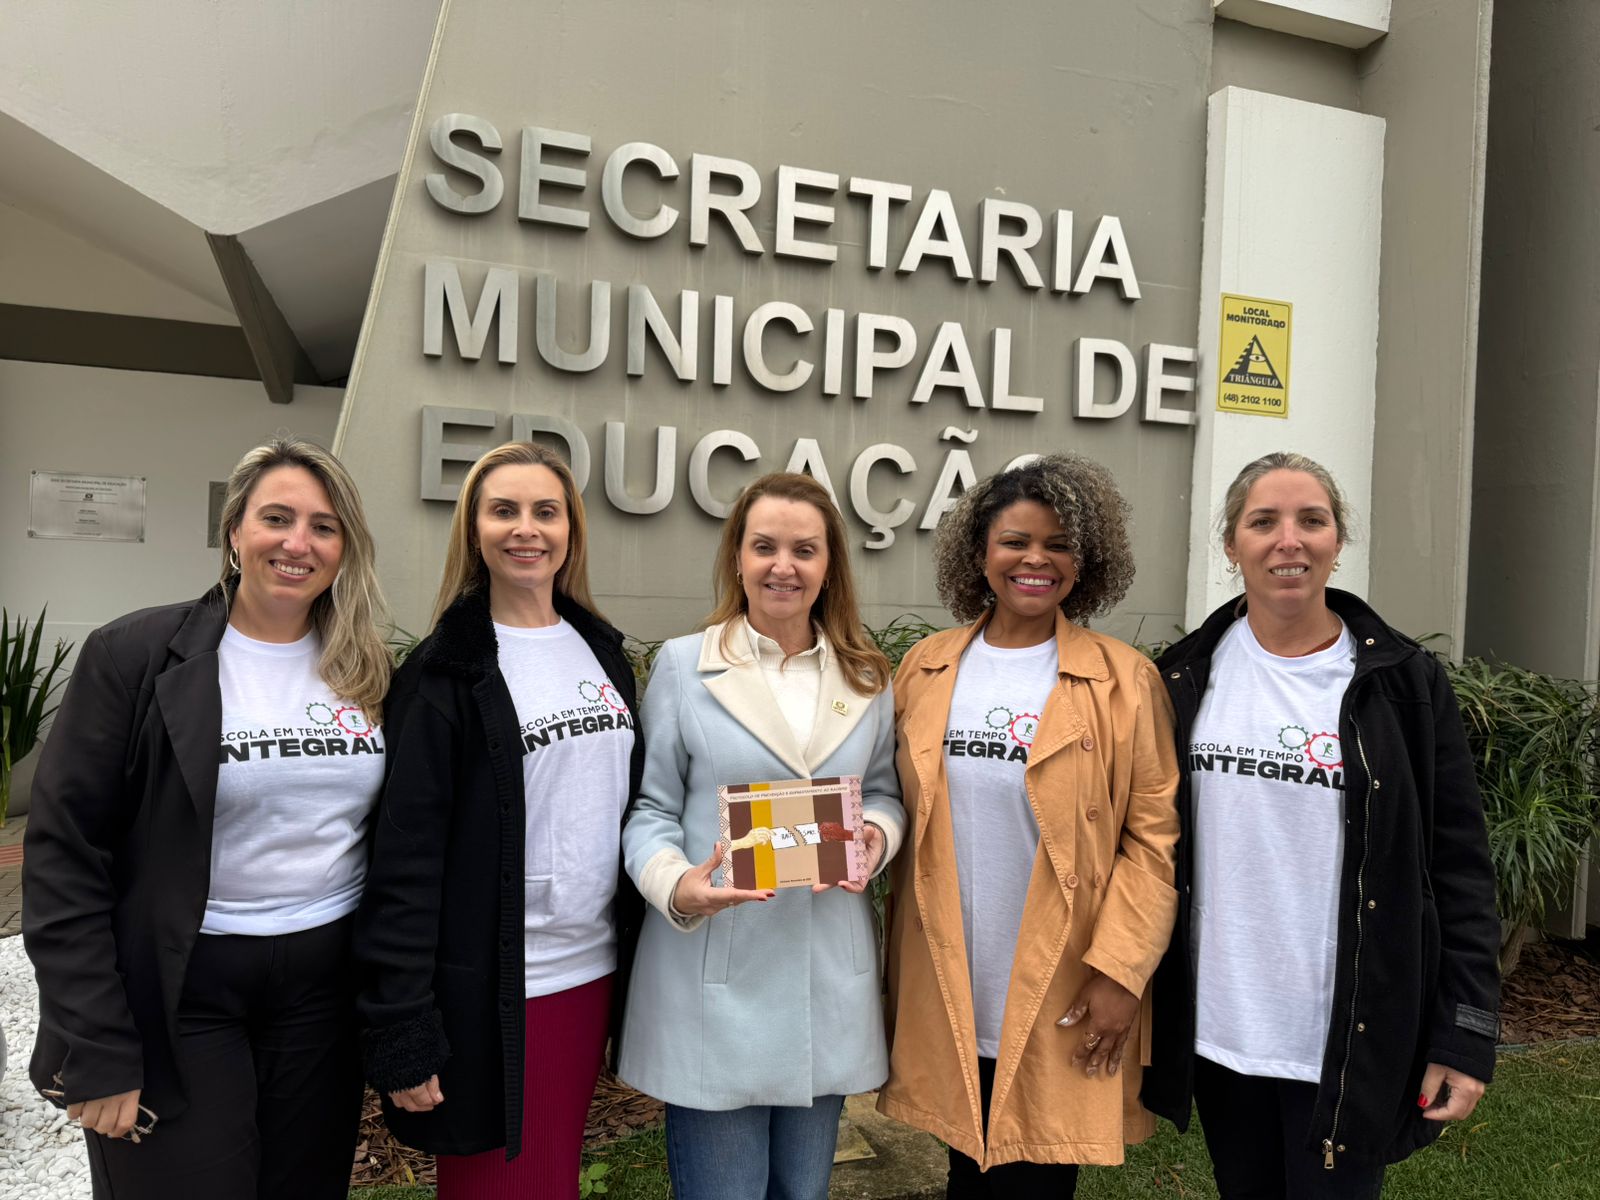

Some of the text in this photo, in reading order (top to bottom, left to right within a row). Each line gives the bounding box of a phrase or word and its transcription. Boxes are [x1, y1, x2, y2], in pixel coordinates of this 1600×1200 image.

[424, 112, 1141, 302] SECRETARIA
[1226, 313, 1286, 329] MONITORADO
[1243, 307, 1270, 318] LOCAL
[423, 261, 1197, 425] MUNICIPAL DE
[1229, 373, 1279, 387] TRIÂNGULO
[1223, 392, 1282, 407] (48) 2102 1100
[421, 405, 1044, 550] EDUCAÇÃ
[520, 704, 609, 735] SCOLA EM TEMPO
[220, 727, 342, 742] SCOLA EM TEMPO
[949, 729, 964, 739] EM
[968, 730, 1008, 741] TEMPO
[219, 737, 385, 764] NTEGRAL
[943, 739, 1028, 764] EGRA
[1188, 742, 1304, 763] ESCOLA EM TEMPO
[1188, 753, 1346, 791] INTEGRAL
